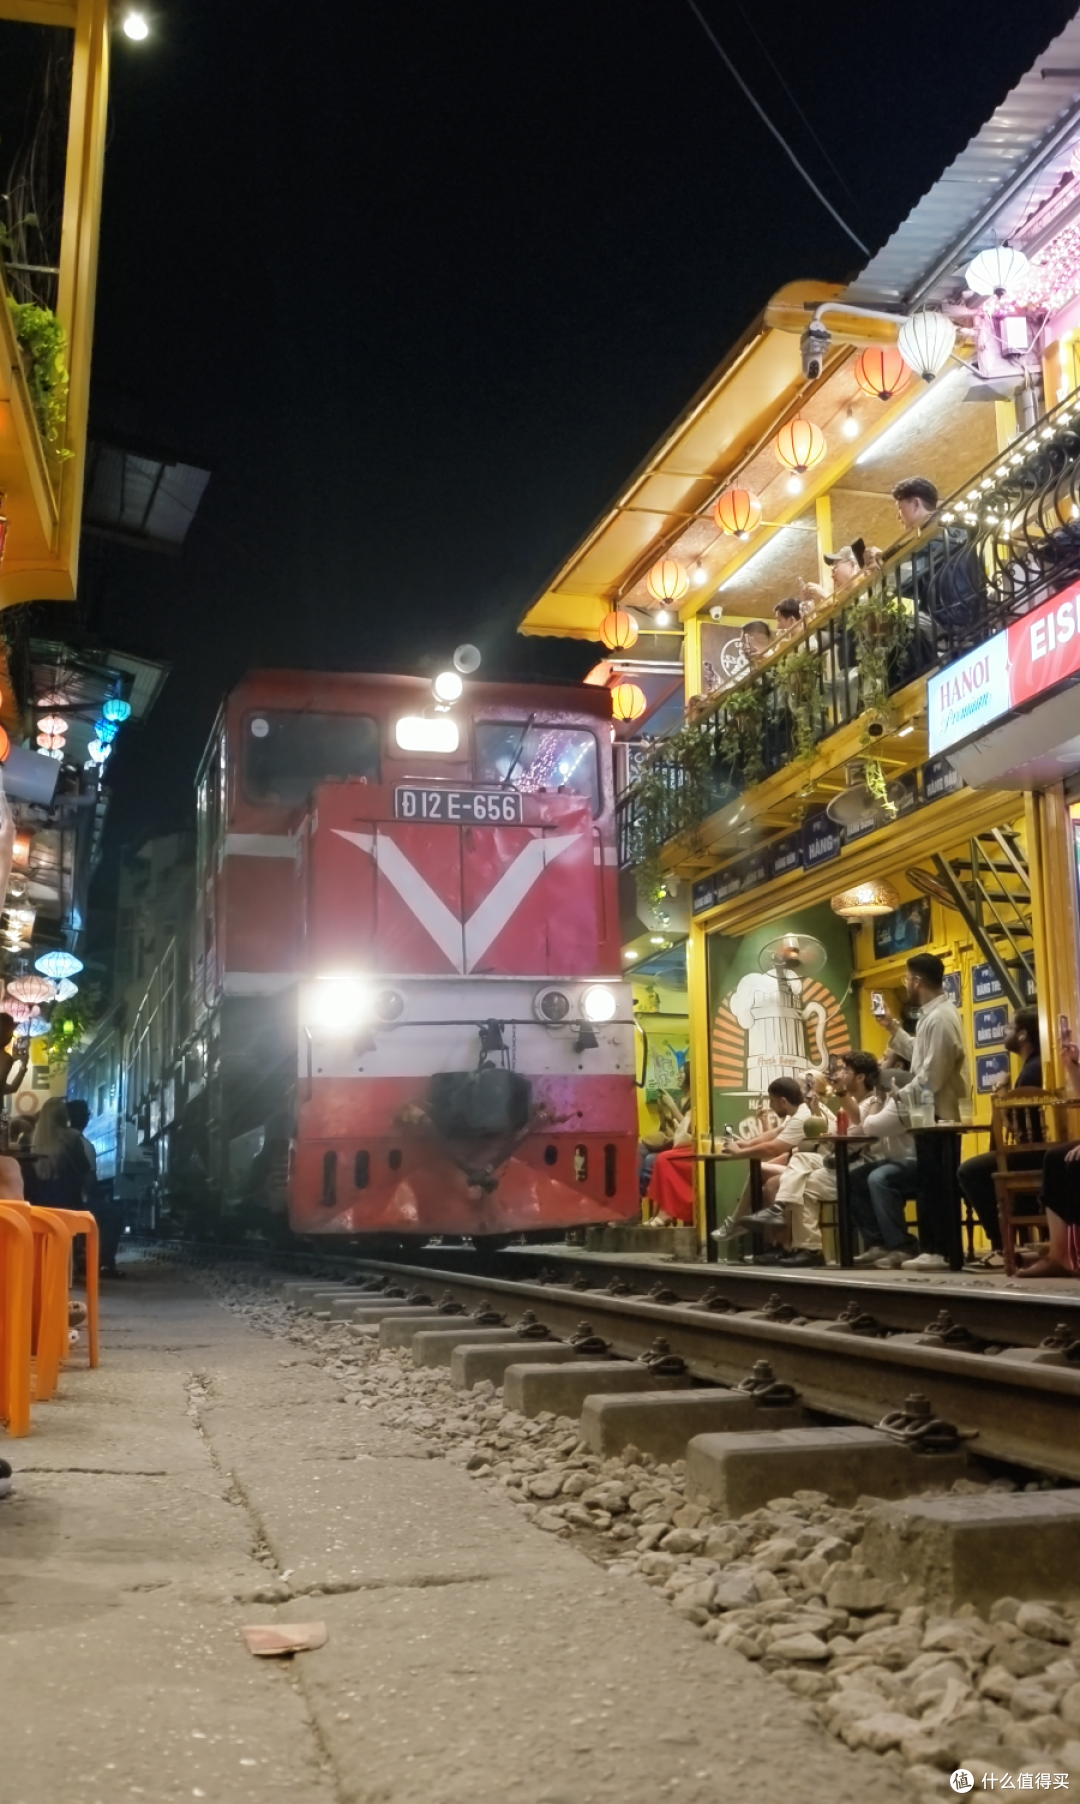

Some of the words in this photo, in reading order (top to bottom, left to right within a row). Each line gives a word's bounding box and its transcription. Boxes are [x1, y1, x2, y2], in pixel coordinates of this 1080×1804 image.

[1030, 594, 1080, 662] EIS
[939, 655, 990, 712] HANOI
[808, 834, 833, 860] HÀNG
